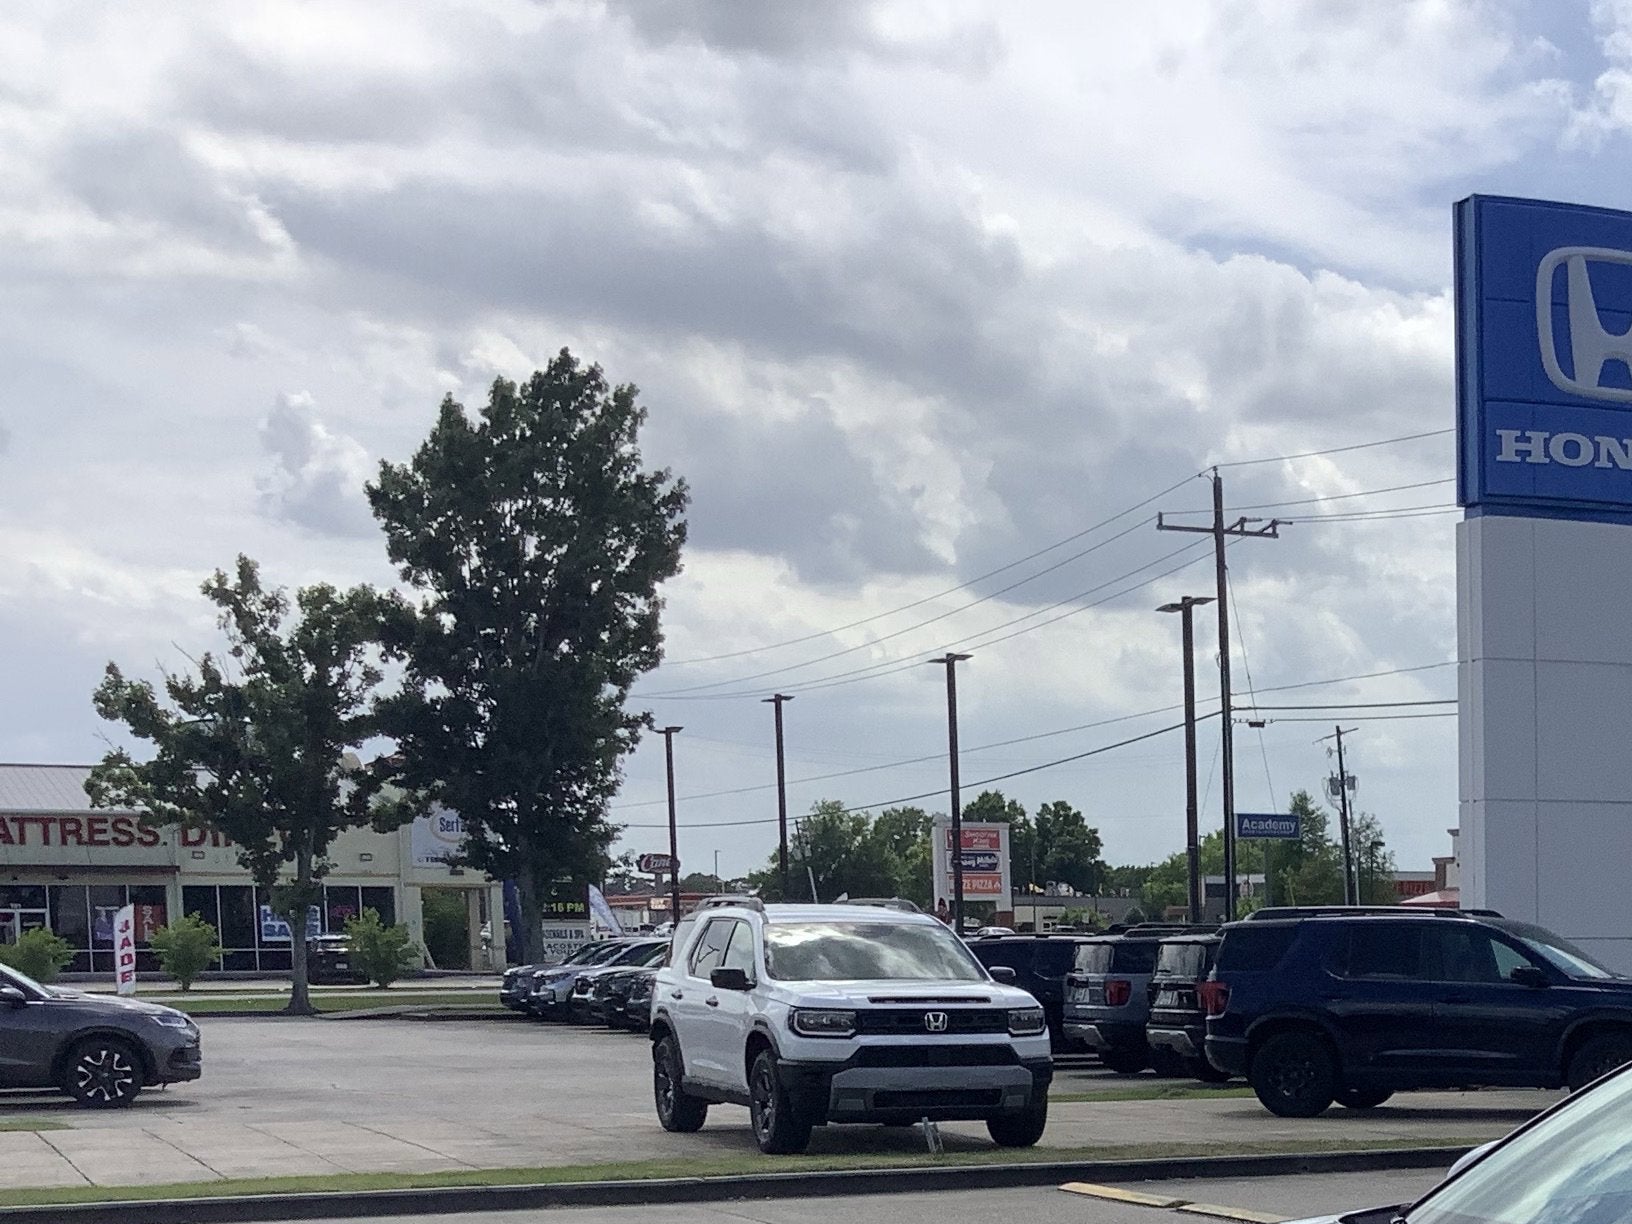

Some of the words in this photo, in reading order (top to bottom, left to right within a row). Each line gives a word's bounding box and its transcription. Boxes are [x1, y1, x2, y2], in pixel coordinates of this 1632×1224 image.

[439, 817, 465, 833] Sert
[1242, 818, 1297, 834] Academy
[566, 902, 585, 912] PM
